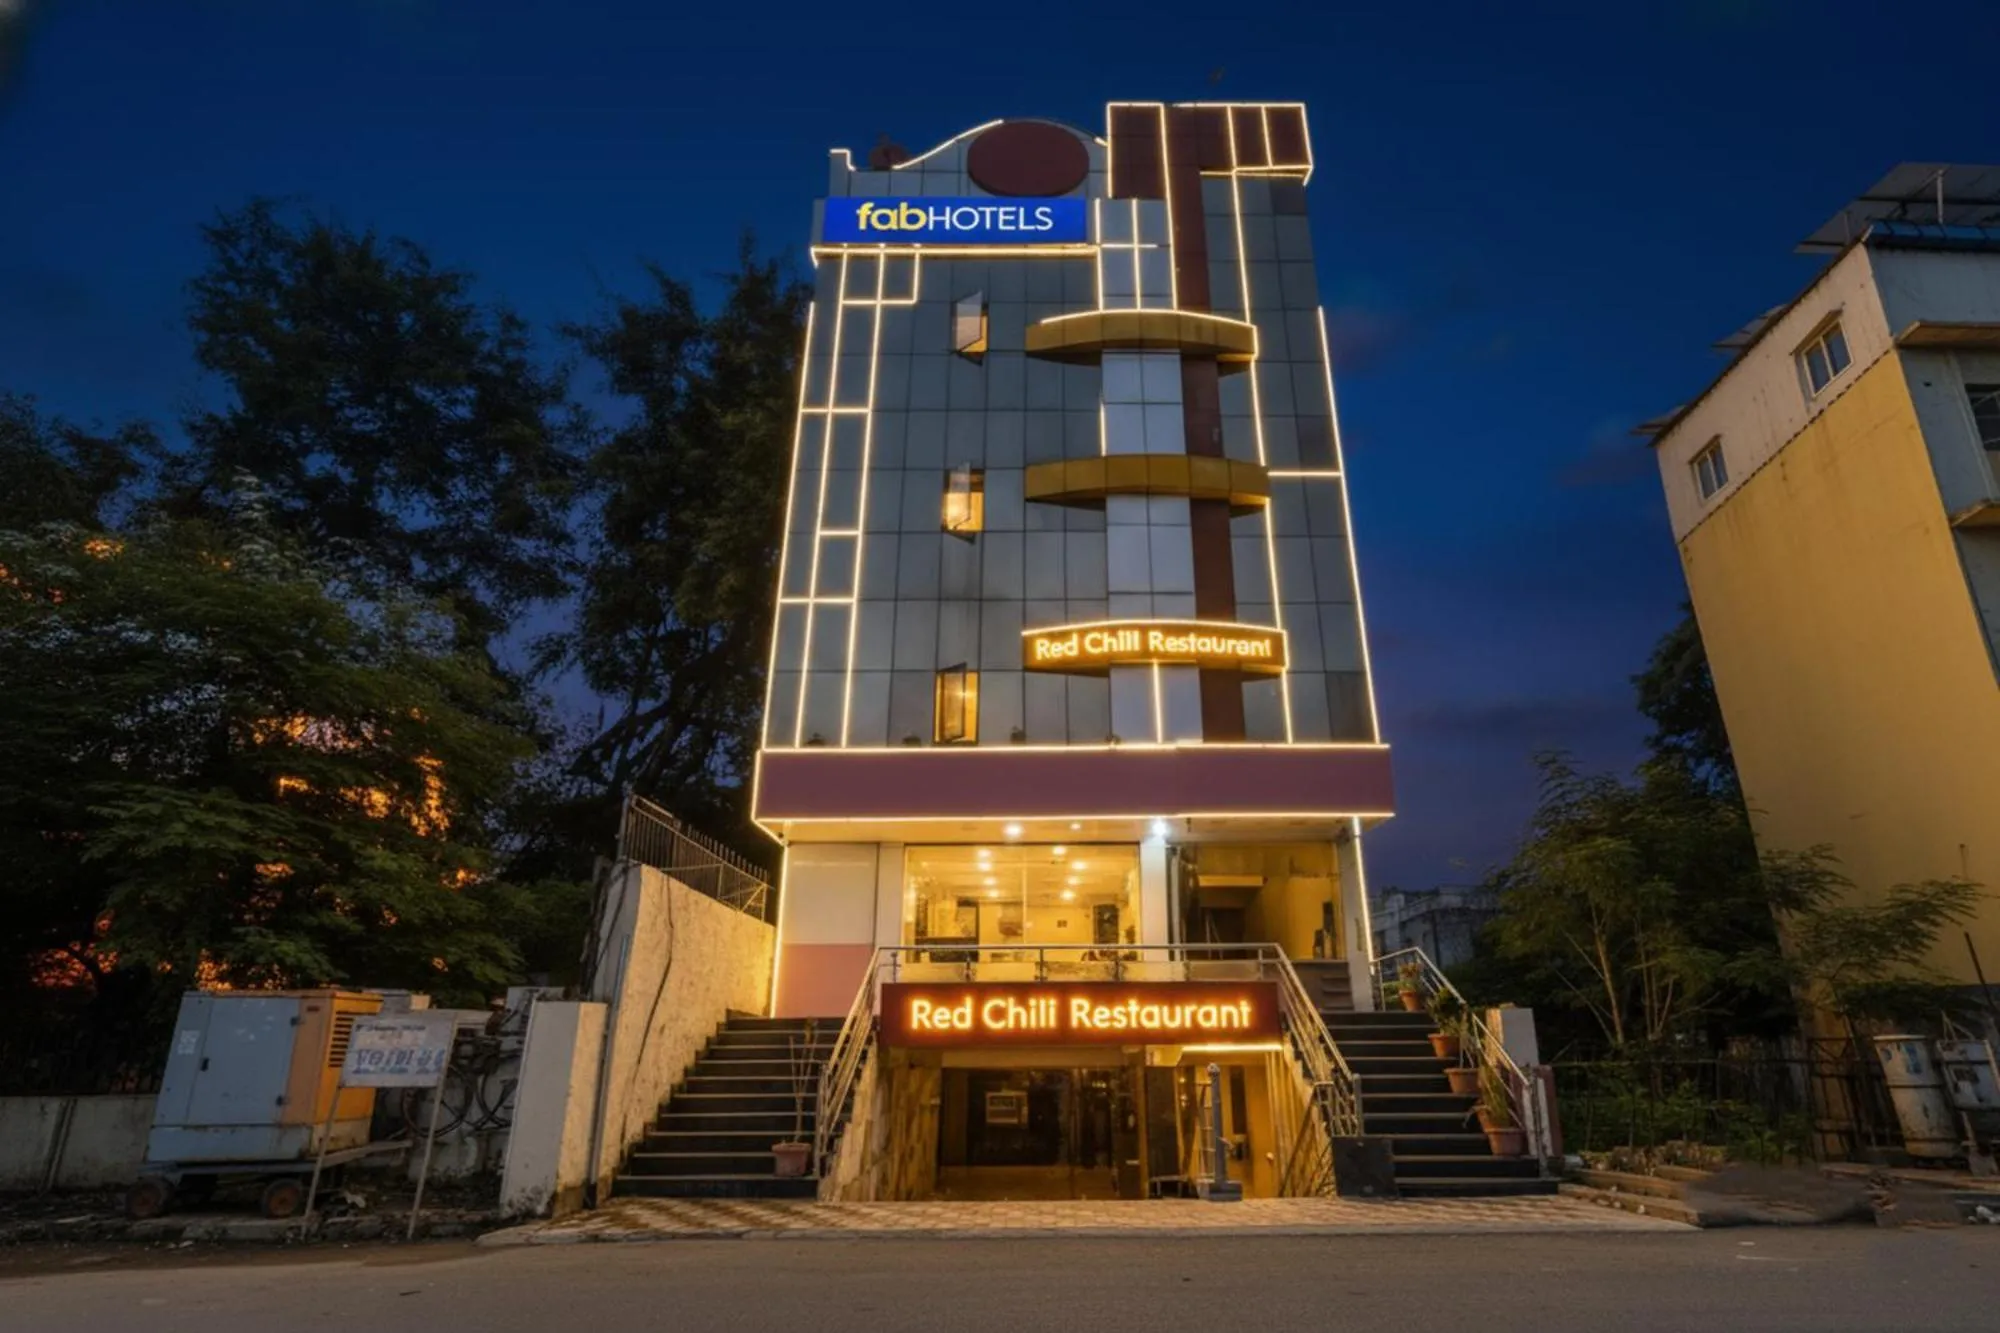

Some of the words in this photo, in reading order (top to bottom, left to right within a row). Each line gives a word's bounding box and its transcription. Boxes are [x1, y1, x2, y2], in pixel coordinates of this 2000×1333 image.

[855, 201, 1054, 232] fabHOTELS
[1035, 632, 1079, 660] Red
[1147, 630, 1272, 657] Restaurant
[910, 996, 973, 1030] Red
[982, 996, 1058, 1030] Chili
[1070, 996, 1252, 1030] Restaurant
